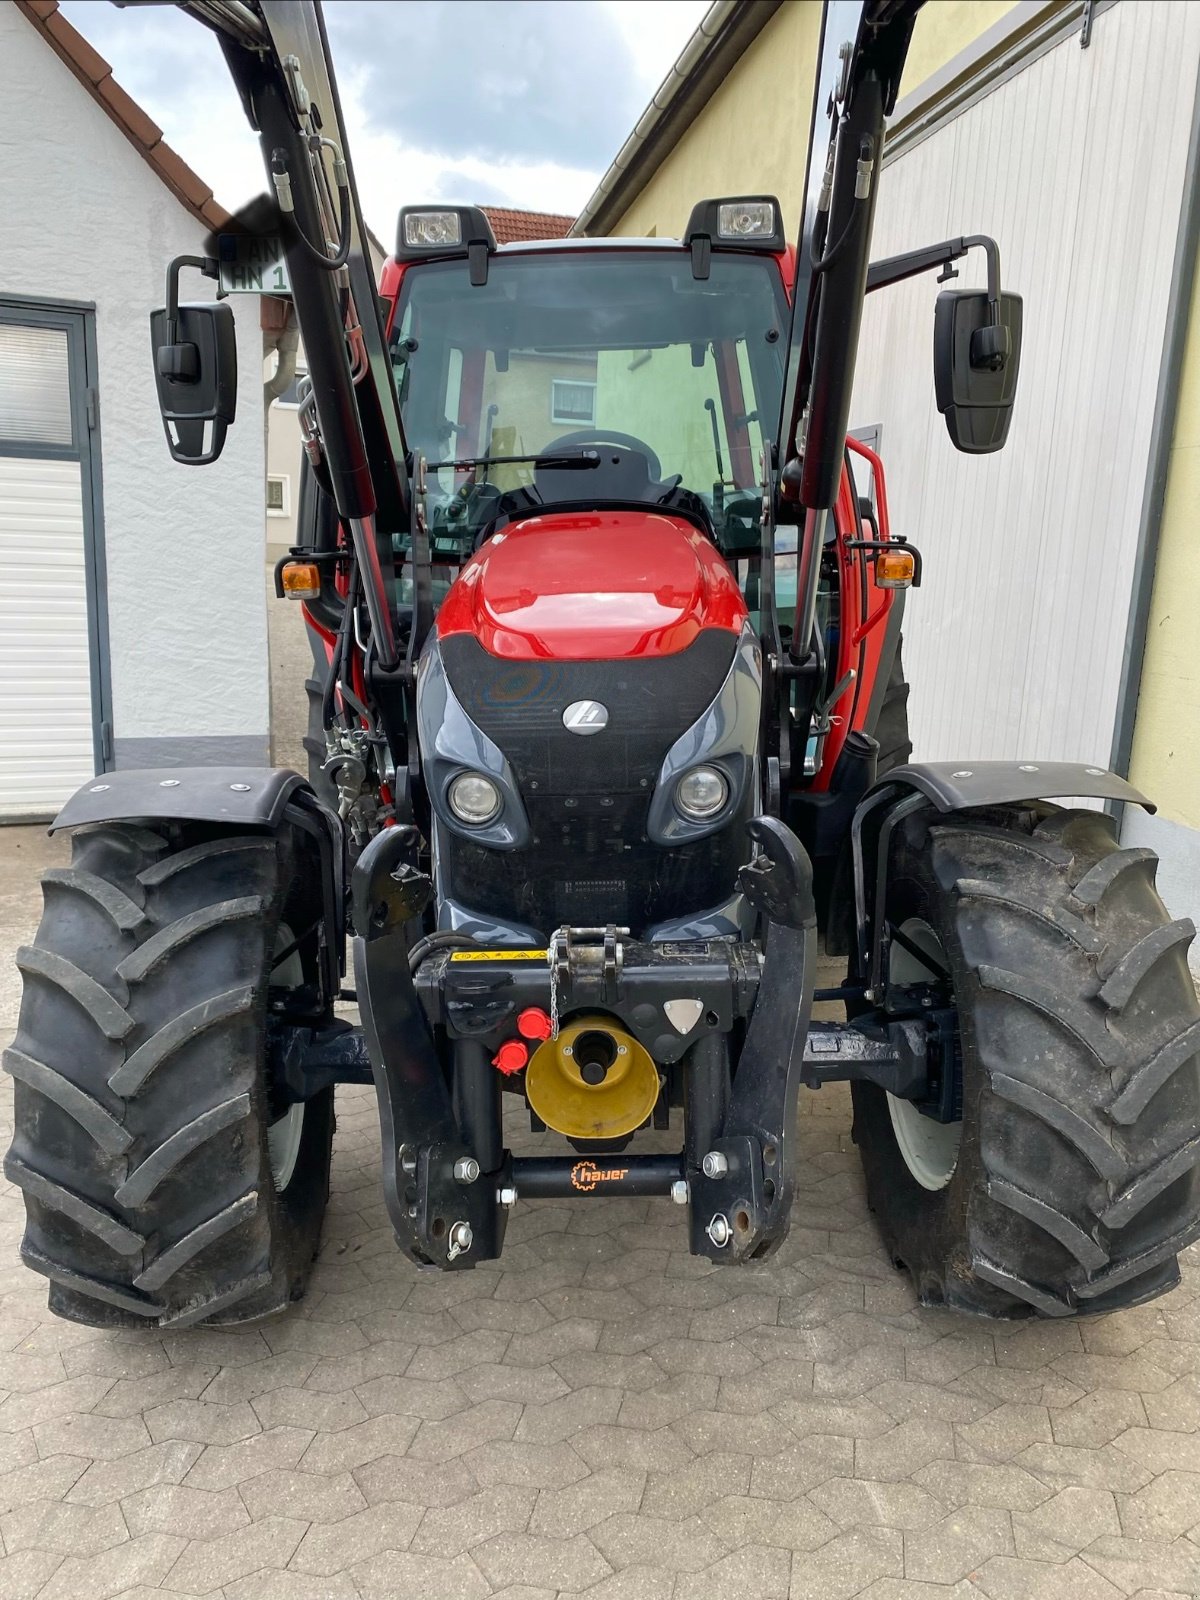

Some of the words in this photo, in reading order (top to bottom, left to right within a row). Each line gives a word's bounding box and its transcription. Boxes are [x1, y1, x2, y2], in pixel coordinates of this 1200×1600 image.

[248, 238, 279, 262] AN
[231, 266, 263, 290] HN
[273, 266, 287, 289] 1
[580, 1167, 629, 1182] hauer
